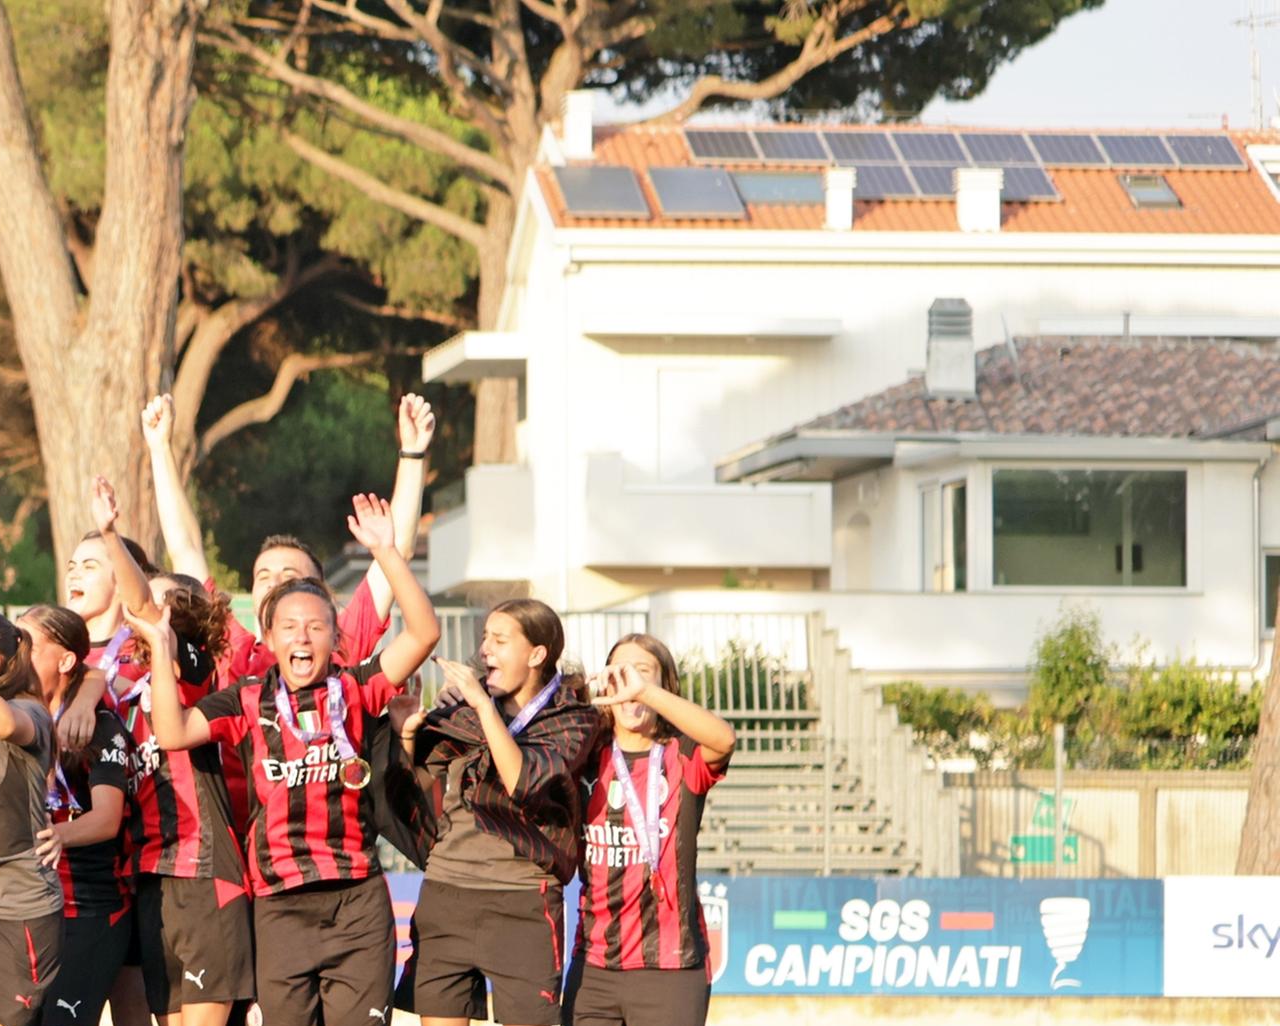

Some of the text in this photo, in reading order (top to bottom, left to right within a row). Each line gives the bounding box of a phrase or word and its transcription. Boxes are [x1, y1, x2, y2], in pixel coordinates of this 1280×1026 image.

[839, 898, 931, 942] SGS
[1212, 914, 1280, 958] sky
[744, 943, 1022, 988] CAMPIONATI
